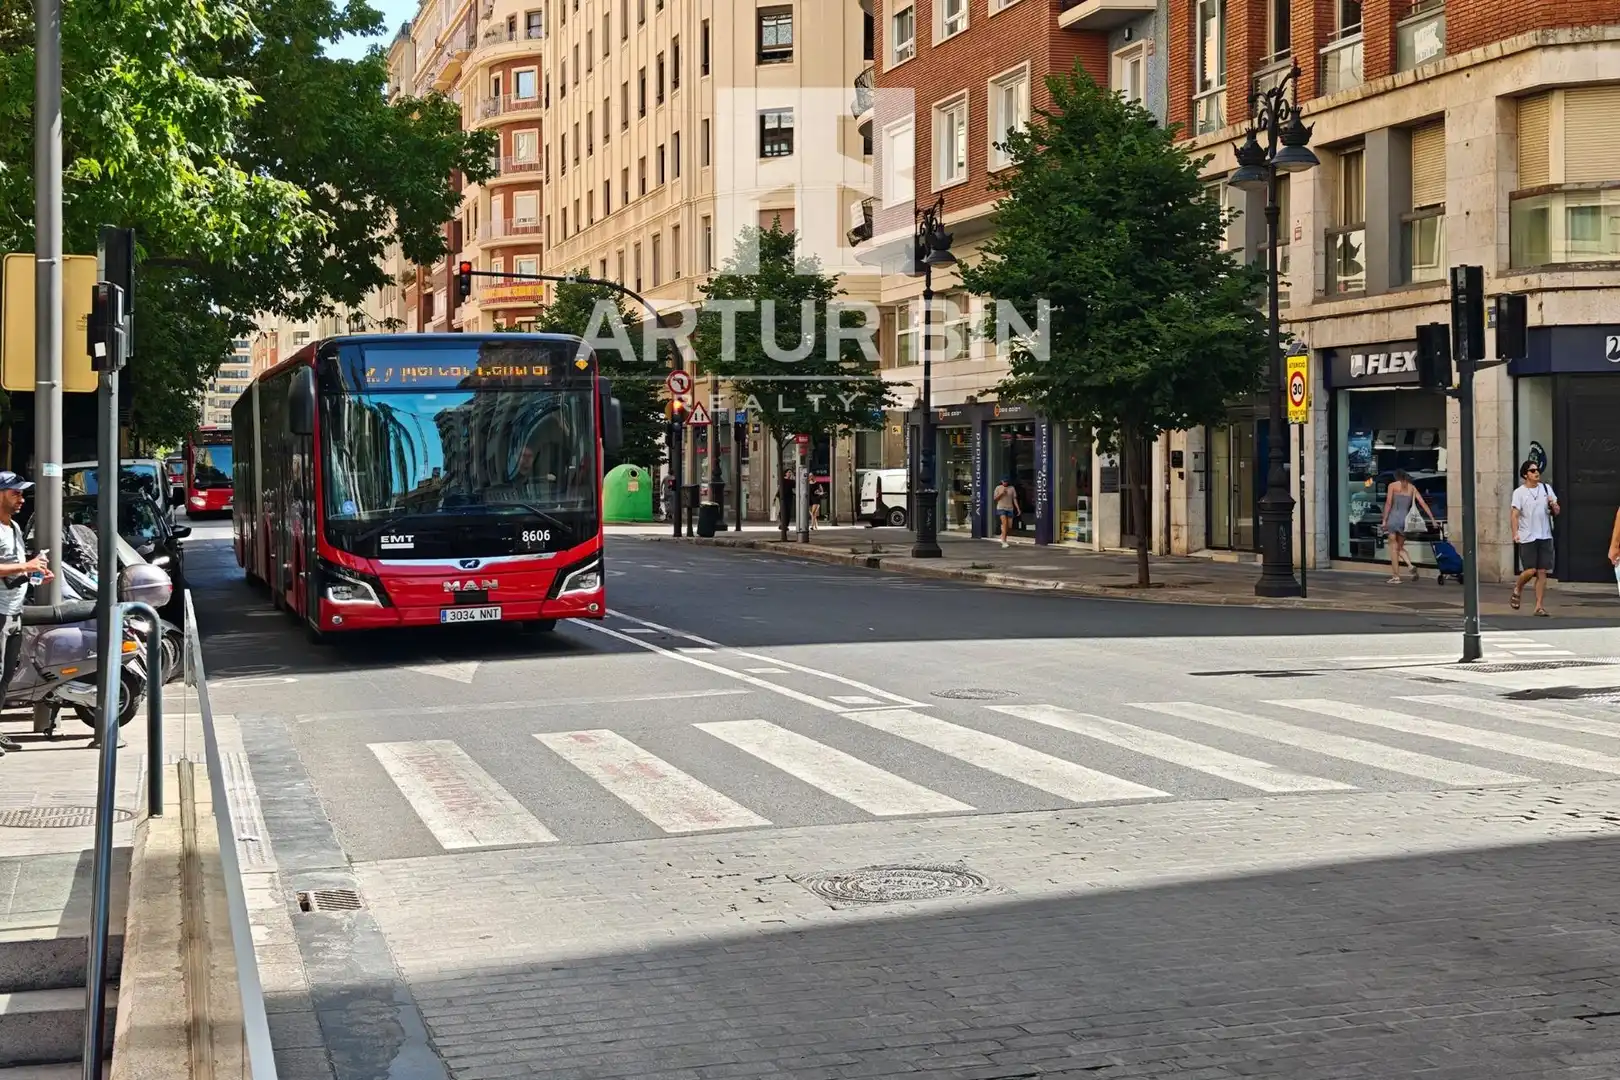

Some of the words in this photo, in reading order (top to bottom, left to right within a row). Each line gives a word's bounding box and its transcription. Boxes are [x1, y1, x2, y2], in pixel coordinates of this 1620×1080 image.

[1367, 350, 1417, 375] FLEX
[1292, 383, 1302, 396] 30
[380, 535, 414, 543] EMT
[521, 530, 551, 542] 8606
[443, 579, 499, 592] MAN
[450, 610, 475, 621] 3034
[480, 608, 500, 619] NNT
